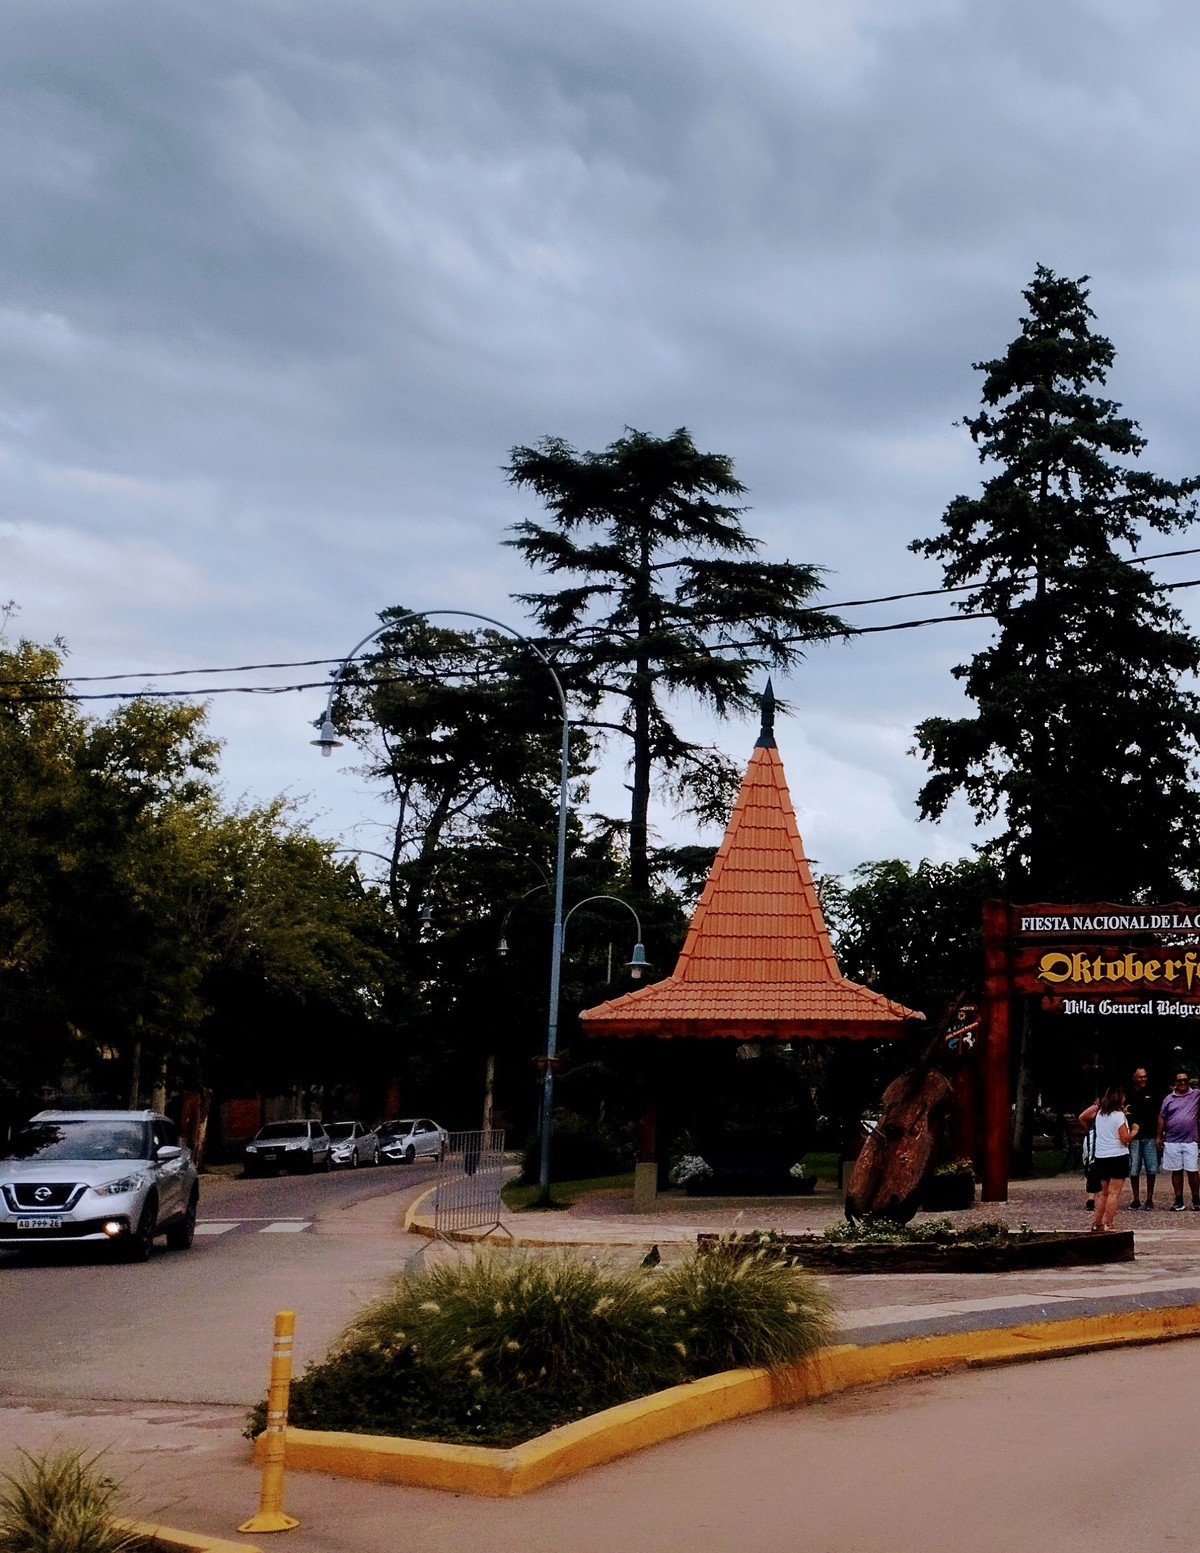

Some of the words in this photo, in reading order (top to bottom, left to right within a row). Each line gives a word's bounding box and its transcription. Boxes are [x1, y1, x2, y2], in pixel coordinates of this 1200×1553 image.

[1020, 916, 1070, 930] FIESTA
[1072, 915, 1148, 930] NACIONAL
[1150, 915, 1171, 929] DE
[1173, 915, 1194, 929] LA
[1062, 999, 1096, 1016] Villa
[1098, 999, 1153, 1016] General
